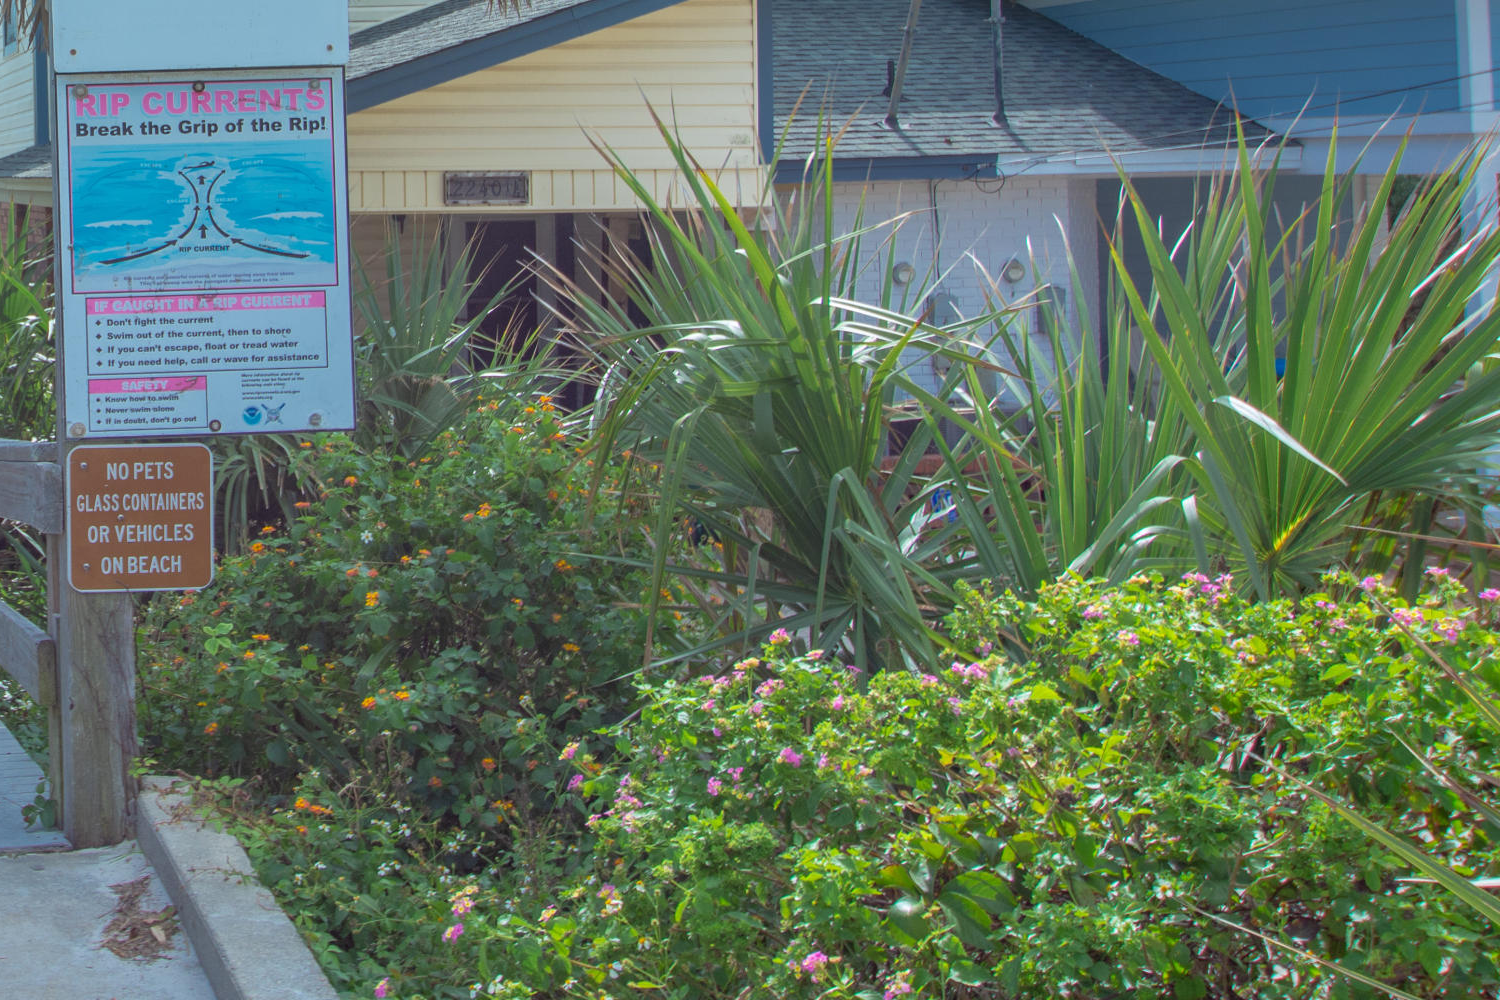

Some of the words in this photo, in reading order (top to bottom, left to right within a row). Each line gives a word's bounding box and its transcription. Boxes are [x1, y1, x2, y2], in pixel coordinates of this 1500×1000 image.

[76, 93, 131, 117] RIP
[142, 88, 325, 116] CURRENTS
[76, 121, 133, 137] Break
[140, 121, 172, 135] the
[178, 119, 218, 137] Grip
[225, 118, 244, 133] of
[251, 118, 282, 132] the
[289, 116, 326, 134] Rip!
[94, 301, 109, 312] IF
[112, 299, 174, 311] CAUGHT
[178, 299, 194, 309] IN
[200, 298, 208, 309] A
[213, 297, 238, 308] RIP
[241, 295, 312, 308] CURRENT
[107, 318, 131, 326] Don't
[134, 317, 157, 327] fight
[159, 317, 175, 325] the
[177, 316, 213, 324] current
[107, 332, 133, 340] Swim
[168, 330, 183, 338] the
[186, 329, 225, 338] current,
[228, 328, 249, 336] then
[264, 327, 291, 335] shore
[107, 345, 115, 353] If
[118, 346, 135, 354] you
[137, 344, 161, 352] can't
[164, 344, 202, 352] escape,
[242, 341, 267, 349] tread
[270, 340, 298, 348] water
[108, 359, 115, 367] If
[118, 360, 135, 368] you
[137, 358, 161, 366] need
[164, 357, 188, 366] help,
[190, 356, 208, 364] call
[211, 356, 221, 364] or
[223, 355, 249, 363] wave
[251, 354, 265, 362] for
[267, 354, 319, 362] assistance
[122, 380, 168, 391] SAFETY
[106, 462, 129, 480] NO
[133, 461, 174, 480] PETS
[76, 493, 120, 512] GLASS
[122, 492, 205, 511] CONTAINERS
[87, 525, 110, 544] OR
[114, 523, 194, 543] VEHICLES
[100, 556, 124, 575] ON
[127, 555, 182, 574] BEACH
